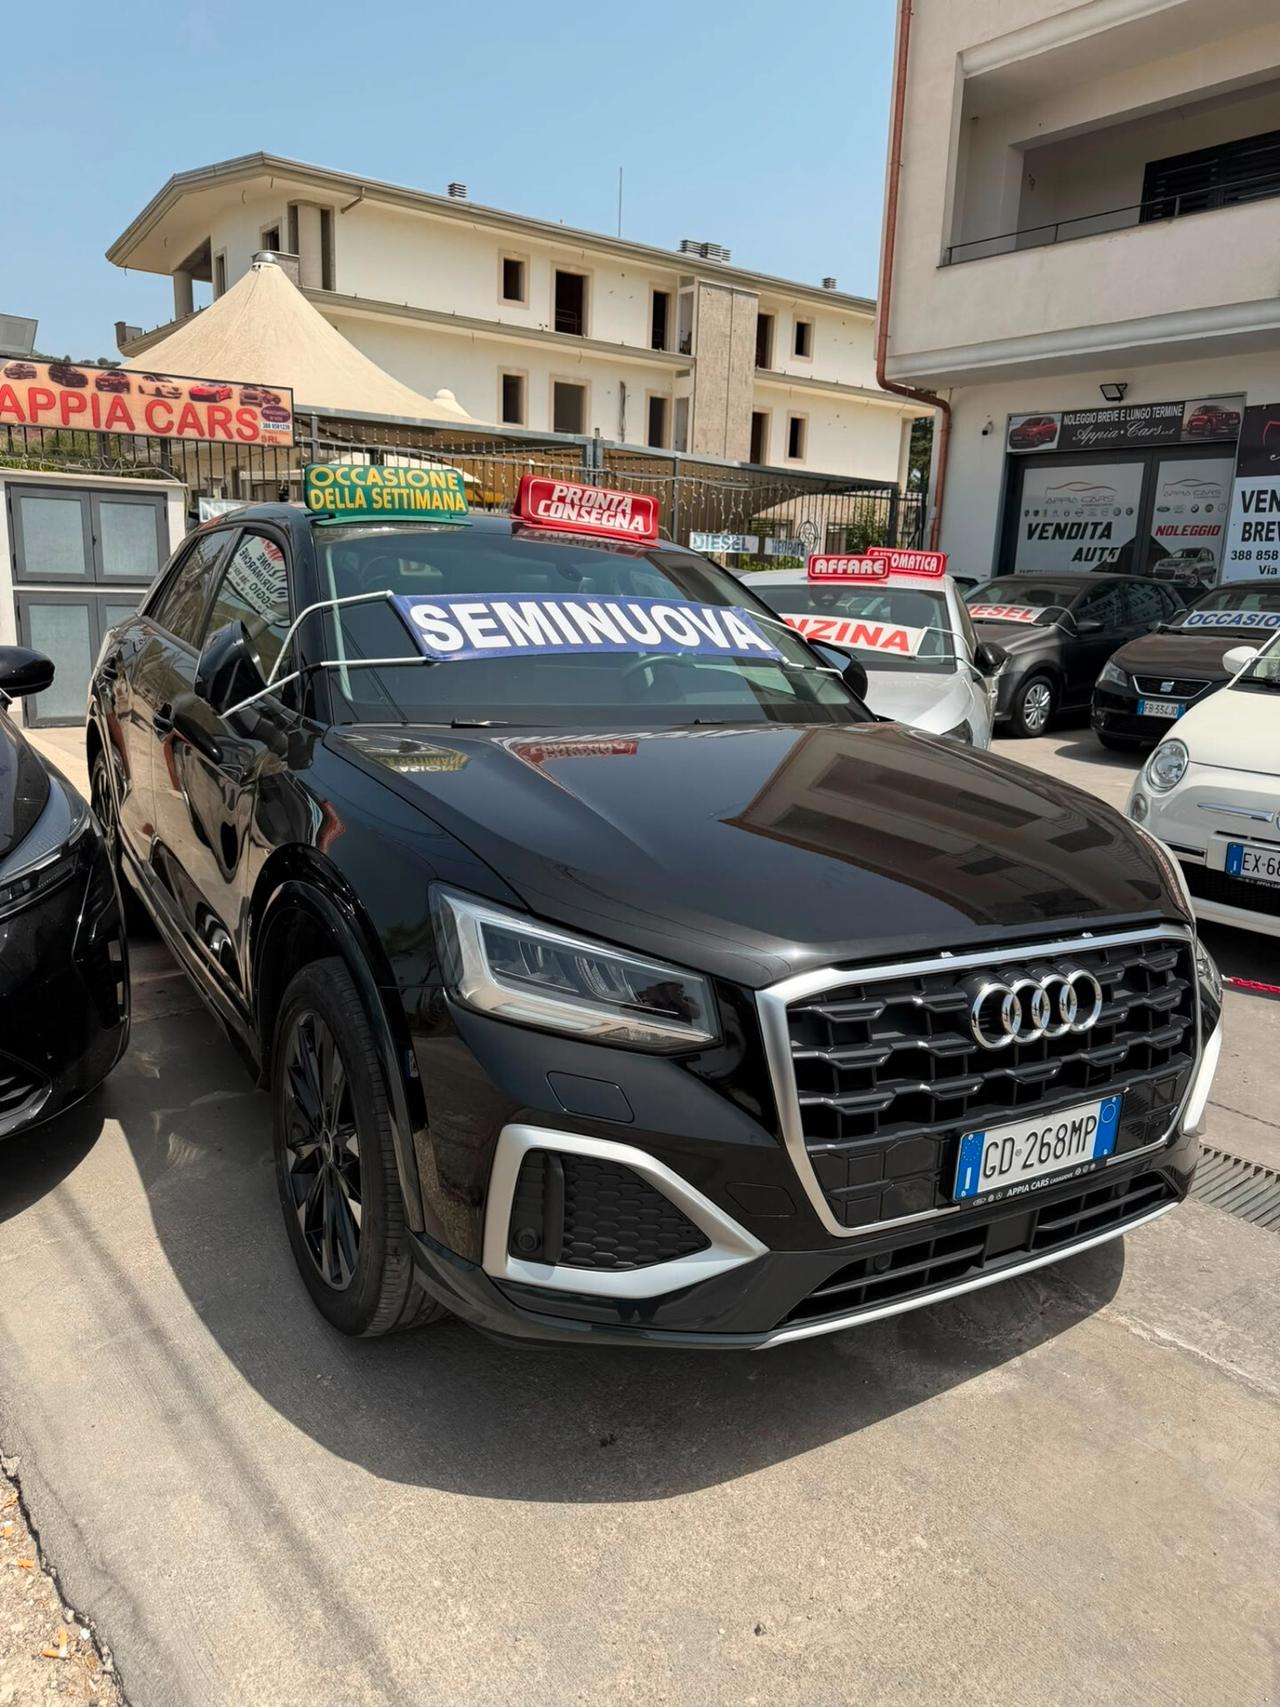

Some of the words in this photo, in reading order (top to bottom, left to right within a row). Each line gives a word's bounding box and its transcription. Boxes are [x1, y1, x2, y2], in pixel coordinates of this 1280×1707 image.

[0, 384, 136, 431] APPIA
[145, 399, 259, 441] CARS
[1063, 412, 1096, 425] NOLEGGIO
[1098, 410, 1119, 423] BREVE
[1120, 409, 1126, 420] E
[1126, 408, 1151, 421] LUNGO
[1152, 405, 1184, 418] TERMINE
[261, 435, 280, 444] SRL
[1072, 425, 1118, 445] Appia
[1126, 421, 1160, 437] Cars
[309, 466, 460, 490] OCCASIONE
[309, 488, 368, 511] DELLA
[372, 489, 467, 512] SETTIMANA
[551, 485, 633, 514] PRONTA
[537, 500, 646, 532] CONSEGNA
[1026, 521, 1113, 541] VENDITA
[1155, 525, 1222, 537] NOLEGGIO
[693, 534, 750, 552] DIESEL
[872, 551, 938, 572] OMATICA
[1071, 546, 1121, 563] AUTO
[1230, 550, 1252, 561] 388
[1256, 550, 1279, 561] 858
[814, 559, 884, 575] AFFARE
[1258, 565, 1278, 575] Via
[408, 601, 775, 652] SEMINUOVA
[1006, 1184, 1030, 1198] APPIA
[1030, 1178, 1050, 1191] CARS
